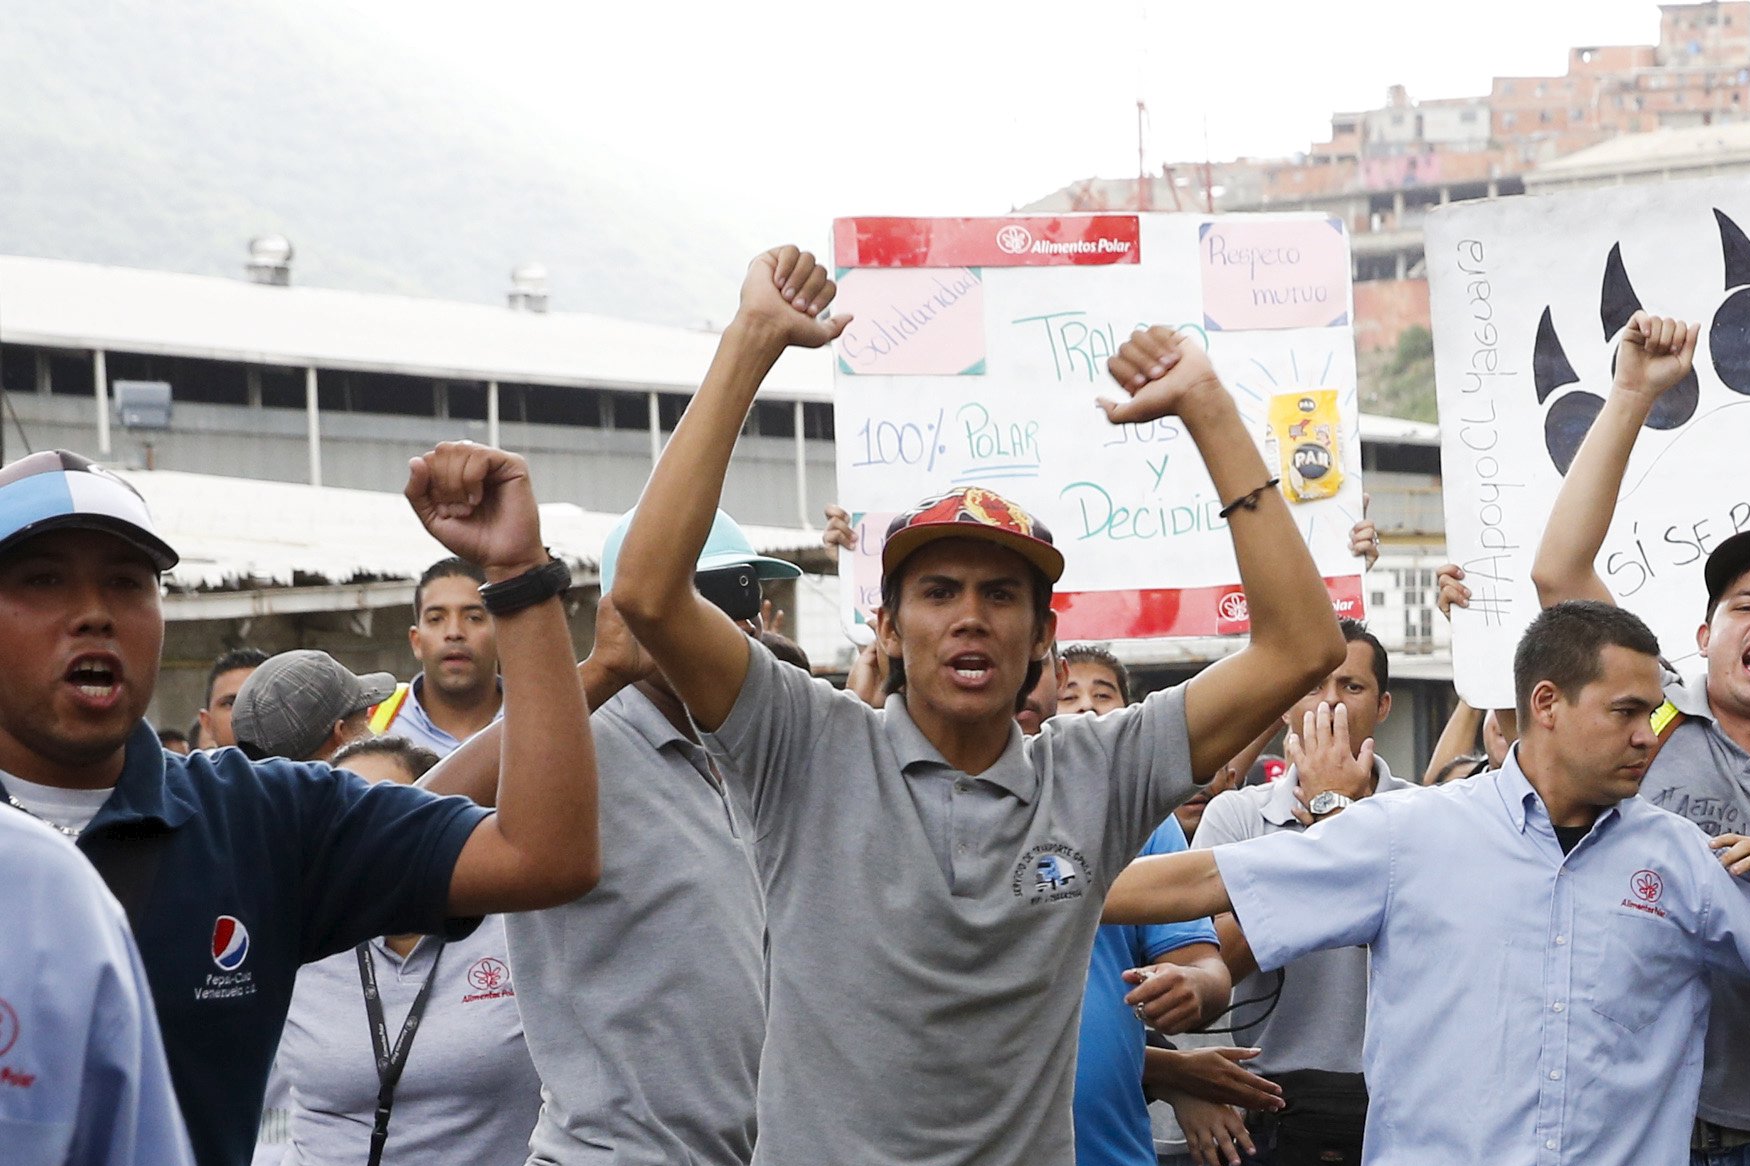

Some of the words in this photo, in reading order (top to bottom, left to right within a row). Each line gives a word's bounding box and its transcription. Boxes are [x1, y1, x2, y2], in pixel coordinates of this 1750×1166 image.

[1031, 238, 1098, 255] Alimentos
[1098, 237, 1131, 253] Polar
[1209, 234, 1301, 281] Respeto
[841, 265, 980, 366] Solidaridad
[852, 407, 946, 473] 100%
